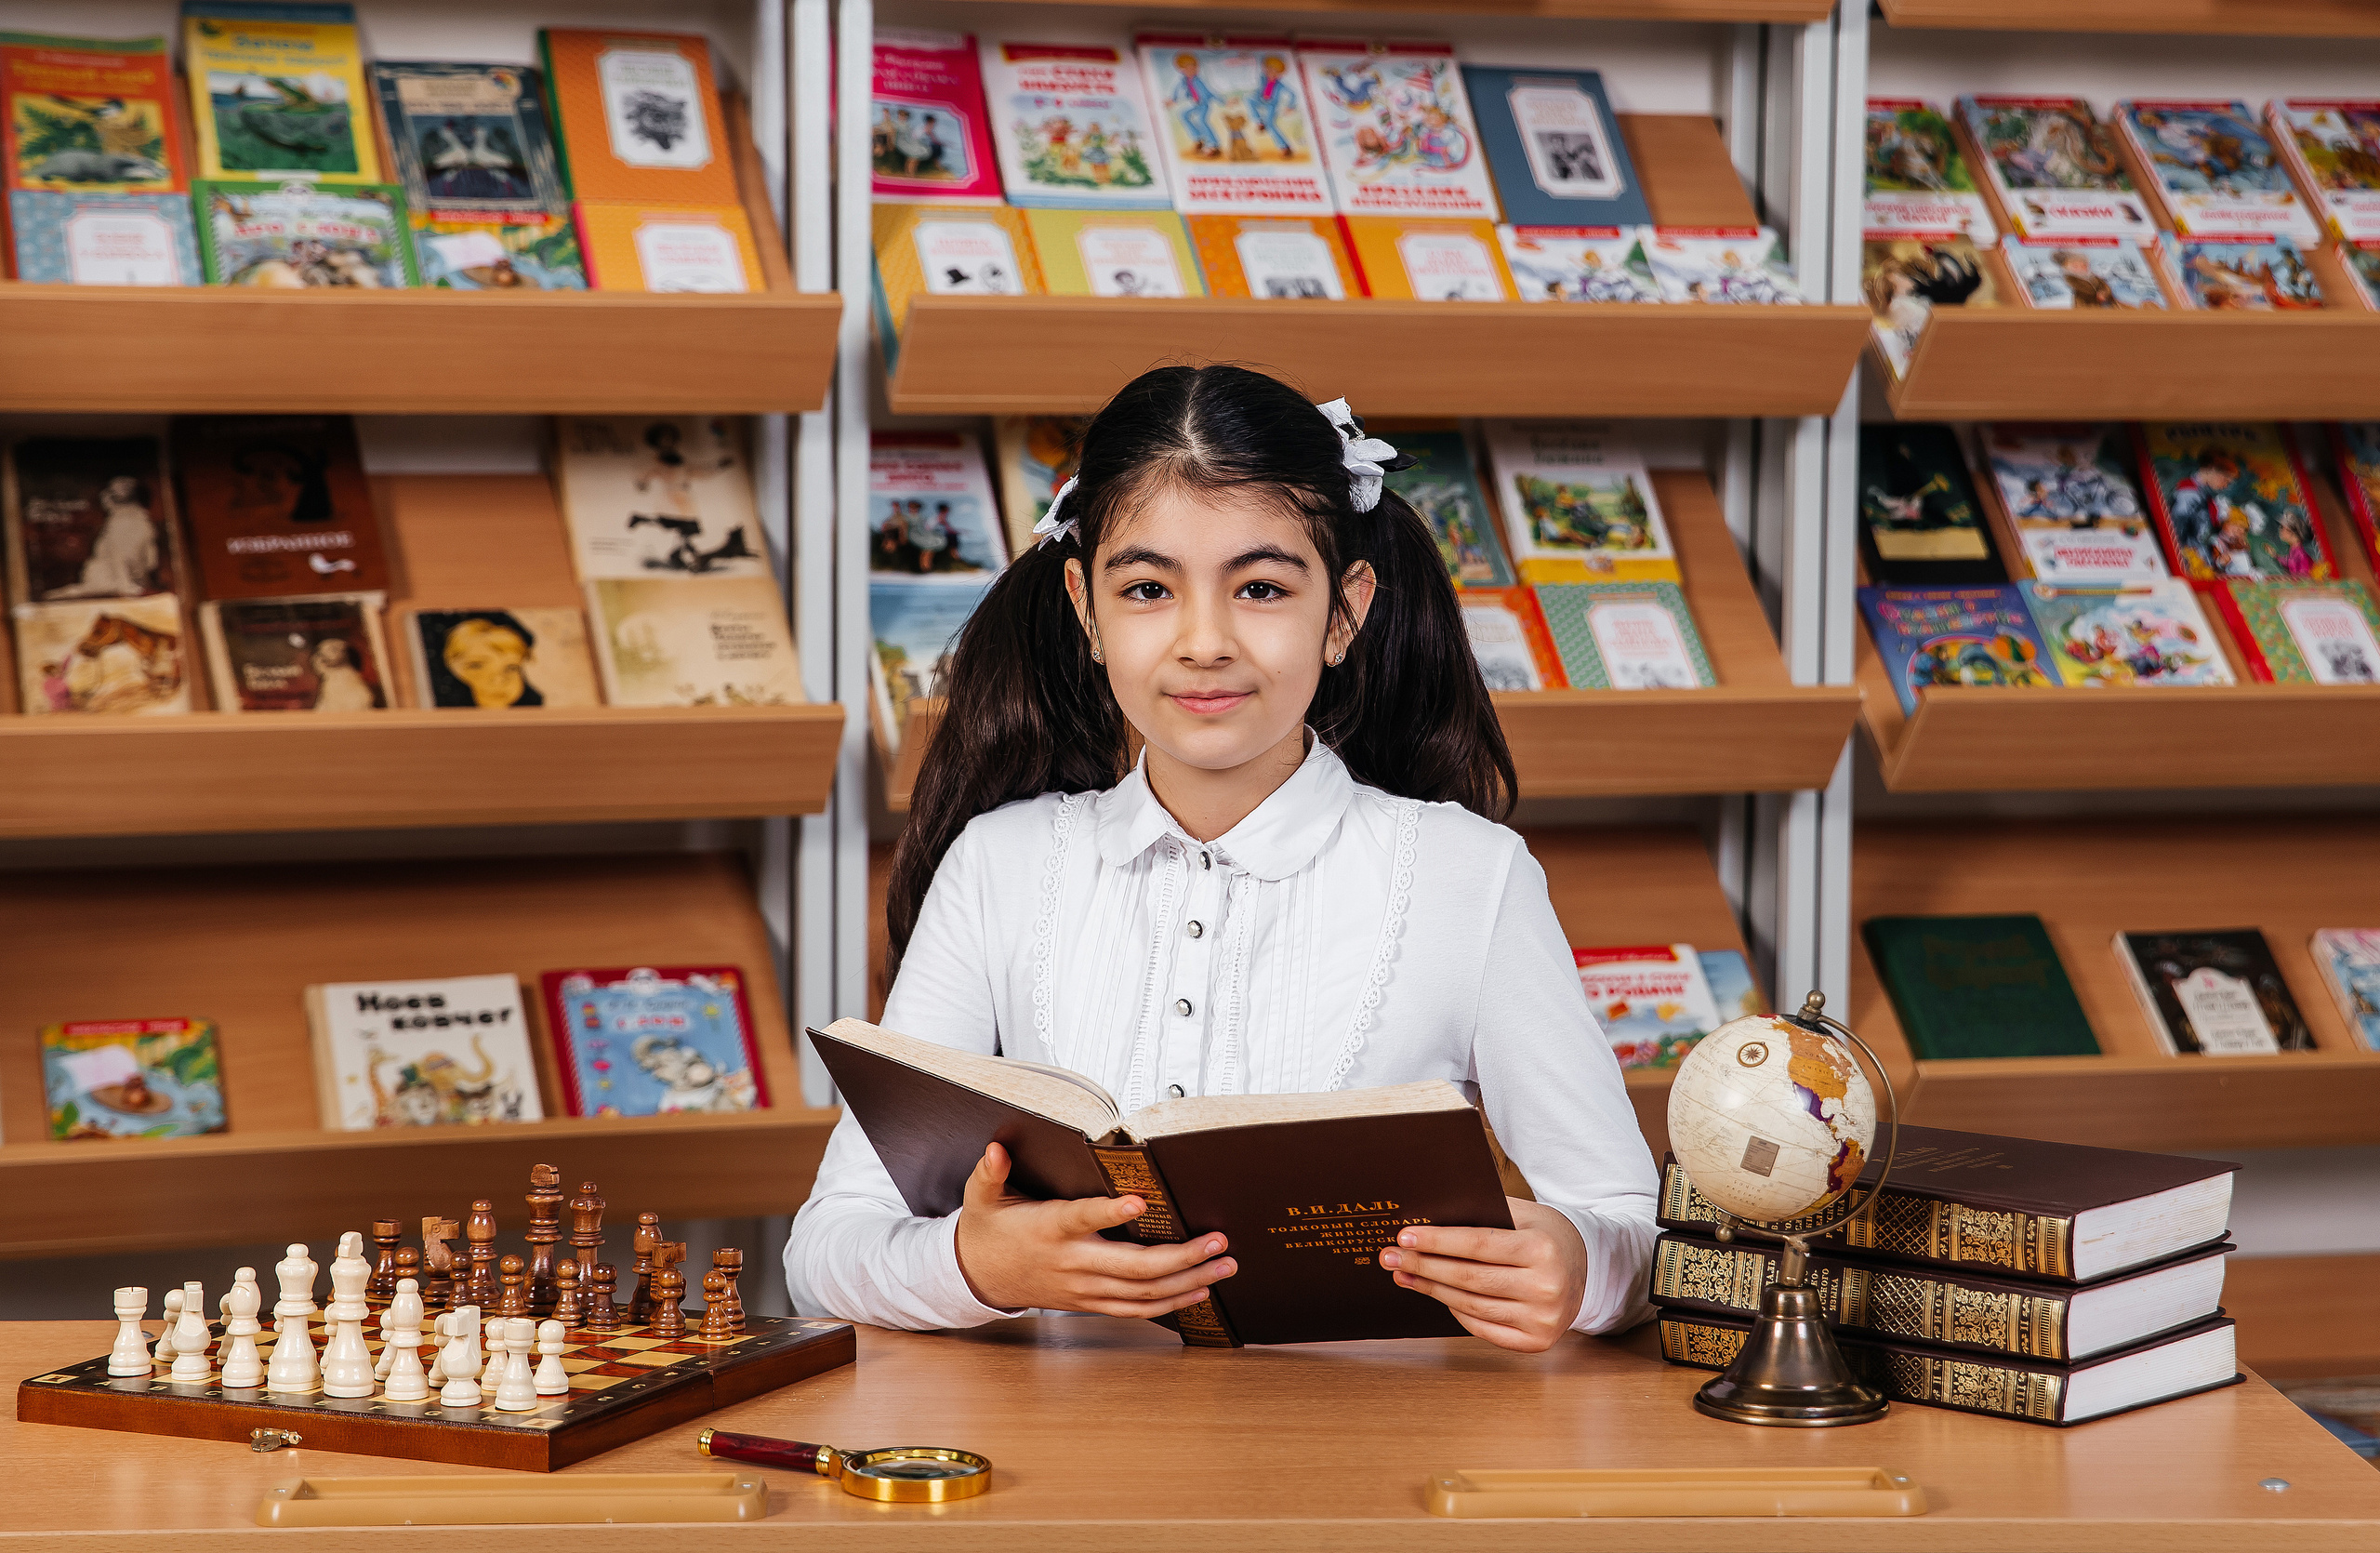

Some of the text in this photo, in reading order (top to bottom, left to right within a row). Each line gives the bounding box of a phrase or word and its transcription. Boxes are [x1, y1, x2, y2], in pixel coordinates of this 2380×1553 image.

[1267, 1217, 1432, 1234] ТОЛКОВЫЙ СЛОВАРЬ
[1320, 1228, 1384, 1238] ЖИВОГО
[1285, 1236, 1396, 1249] ВЕЛИКОРУССК
[1830, 1278, 1839, 1311] ЯЗЫКА
